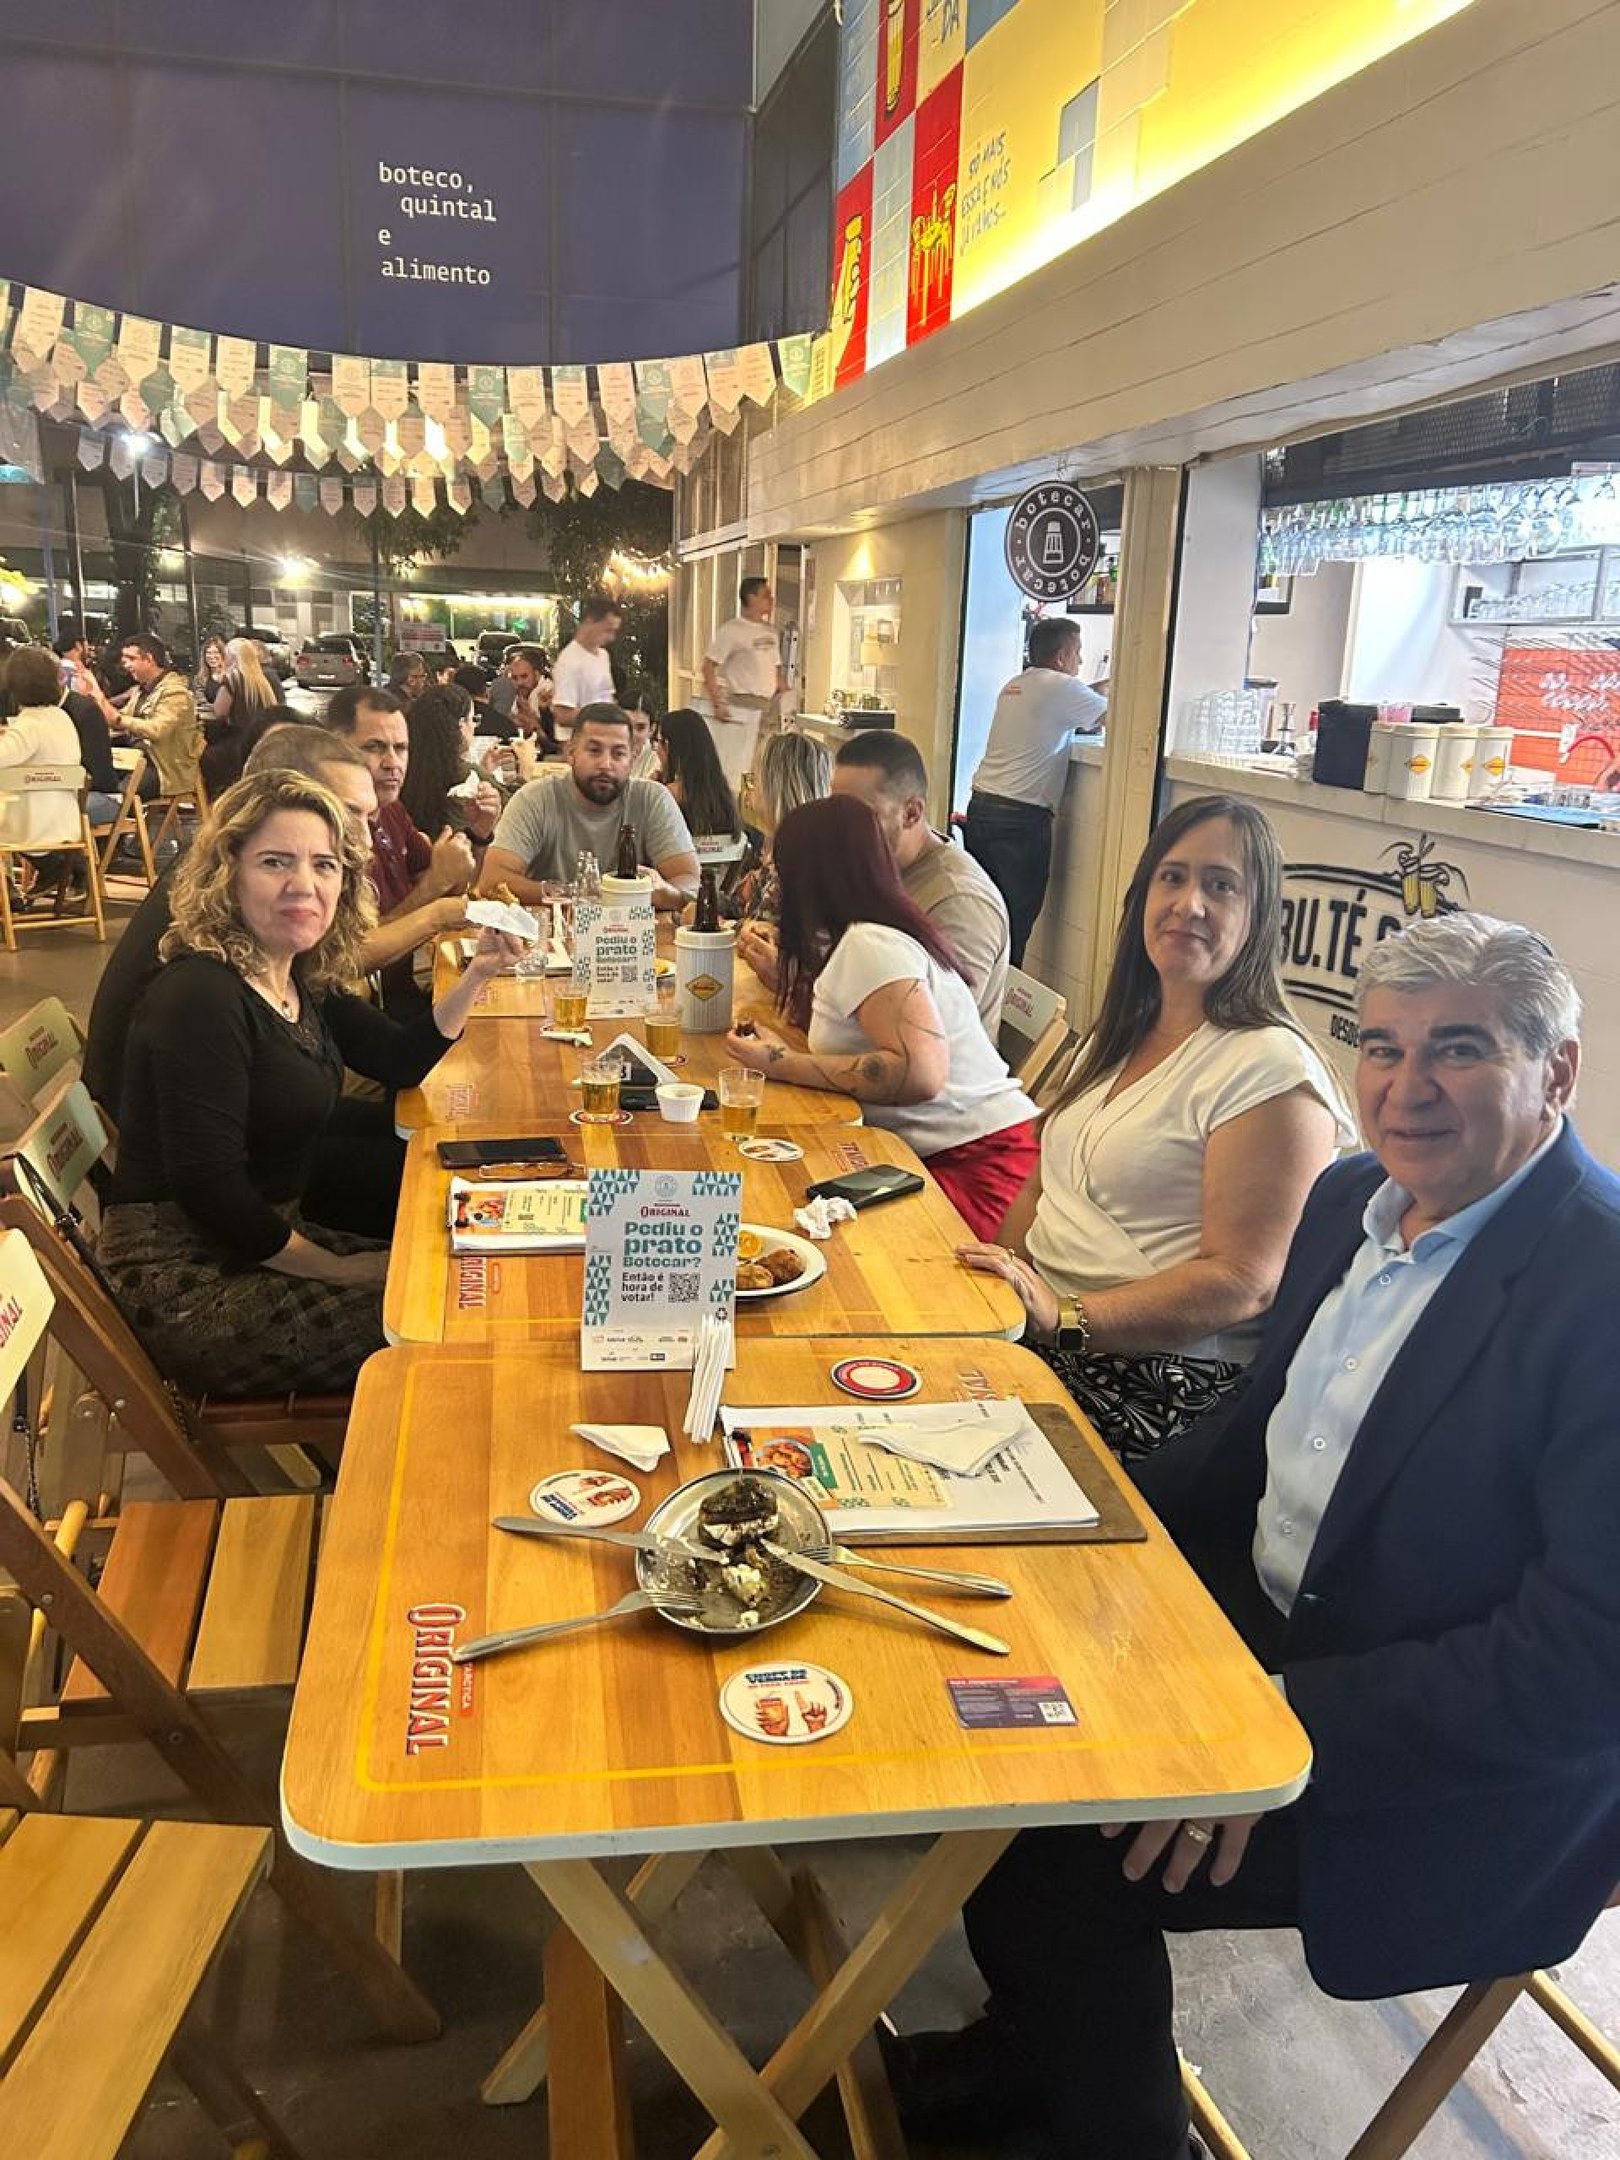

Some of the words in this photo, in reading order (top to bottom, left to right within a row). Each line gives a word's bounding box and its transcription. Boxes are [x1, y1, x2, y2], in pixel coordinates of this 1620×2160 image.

[379, 161, 473, 193] boteco,
[400, 193, 497, 222] quintal
[378, 228, 391, 246] e
[381, 256, 491, 285] alimento
[1015, 490, 1092, 530] botecar
[1015, 554, 1093, 594] botecar
[596, 944, 637, 956] prato
[640, 1206, 691, 1218] ORIGINAL
[624, 1222, 687, 1236] Pediu
[690, 1224, 703, 1236] o
[623, 1236, 703, 1256] prato
[623, 1256, 702, 1268] Botecar?
[458, 1255, 487, 1310] RIGINAL
[621, 1272, 656, 1282] Então
[657, 1272, 664, 1282] é
[621, 1282, 648, 1292] hora
[649, 1282, 664, 1292] de
[620, 1292, 654, 1302] votar!
[406, 1603, 466, 1756] ORIGINAL
